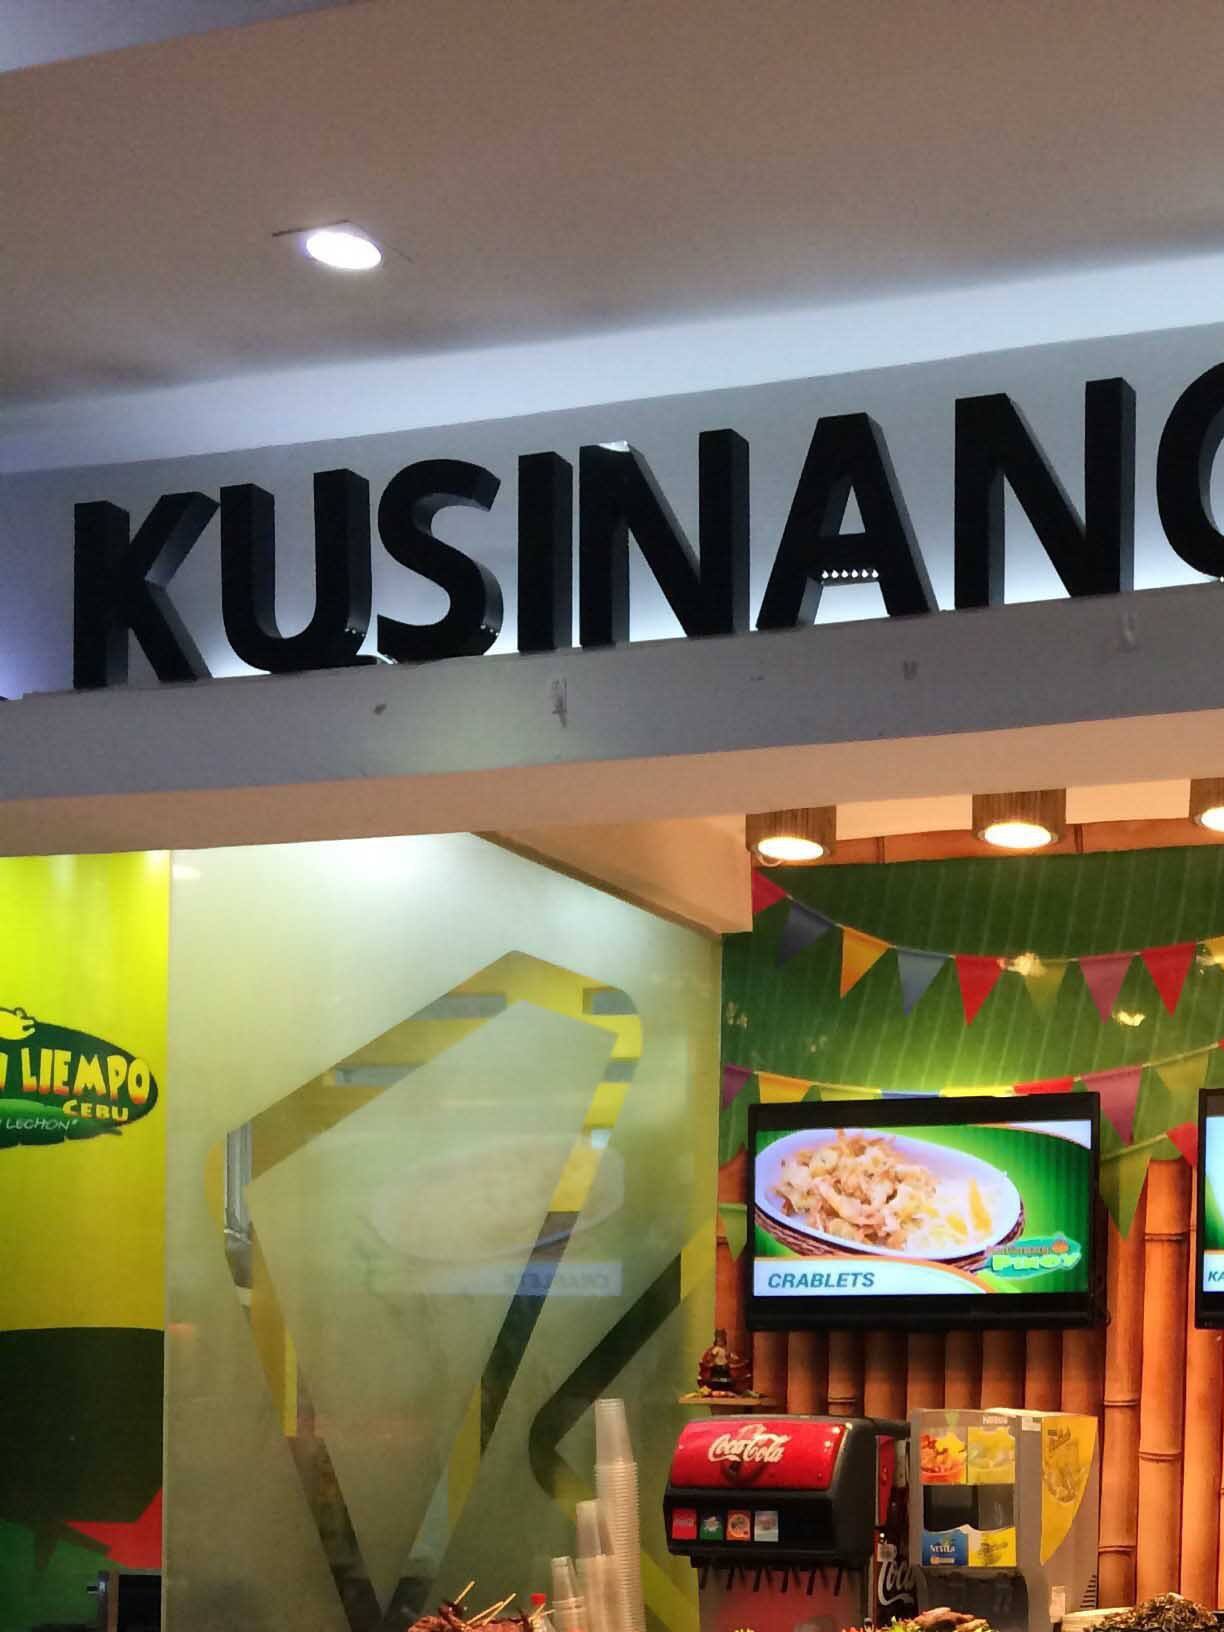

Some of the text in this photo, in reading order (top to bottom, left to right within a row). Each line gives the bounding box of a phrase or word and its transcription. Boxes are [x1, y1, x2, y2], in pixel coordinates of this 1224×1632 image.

[20, 1047, 151, 1105] LIEMPO
[62, 1098, 129, 1122] CEBU
[767, 1271, 876, 1290] CRABLETS
